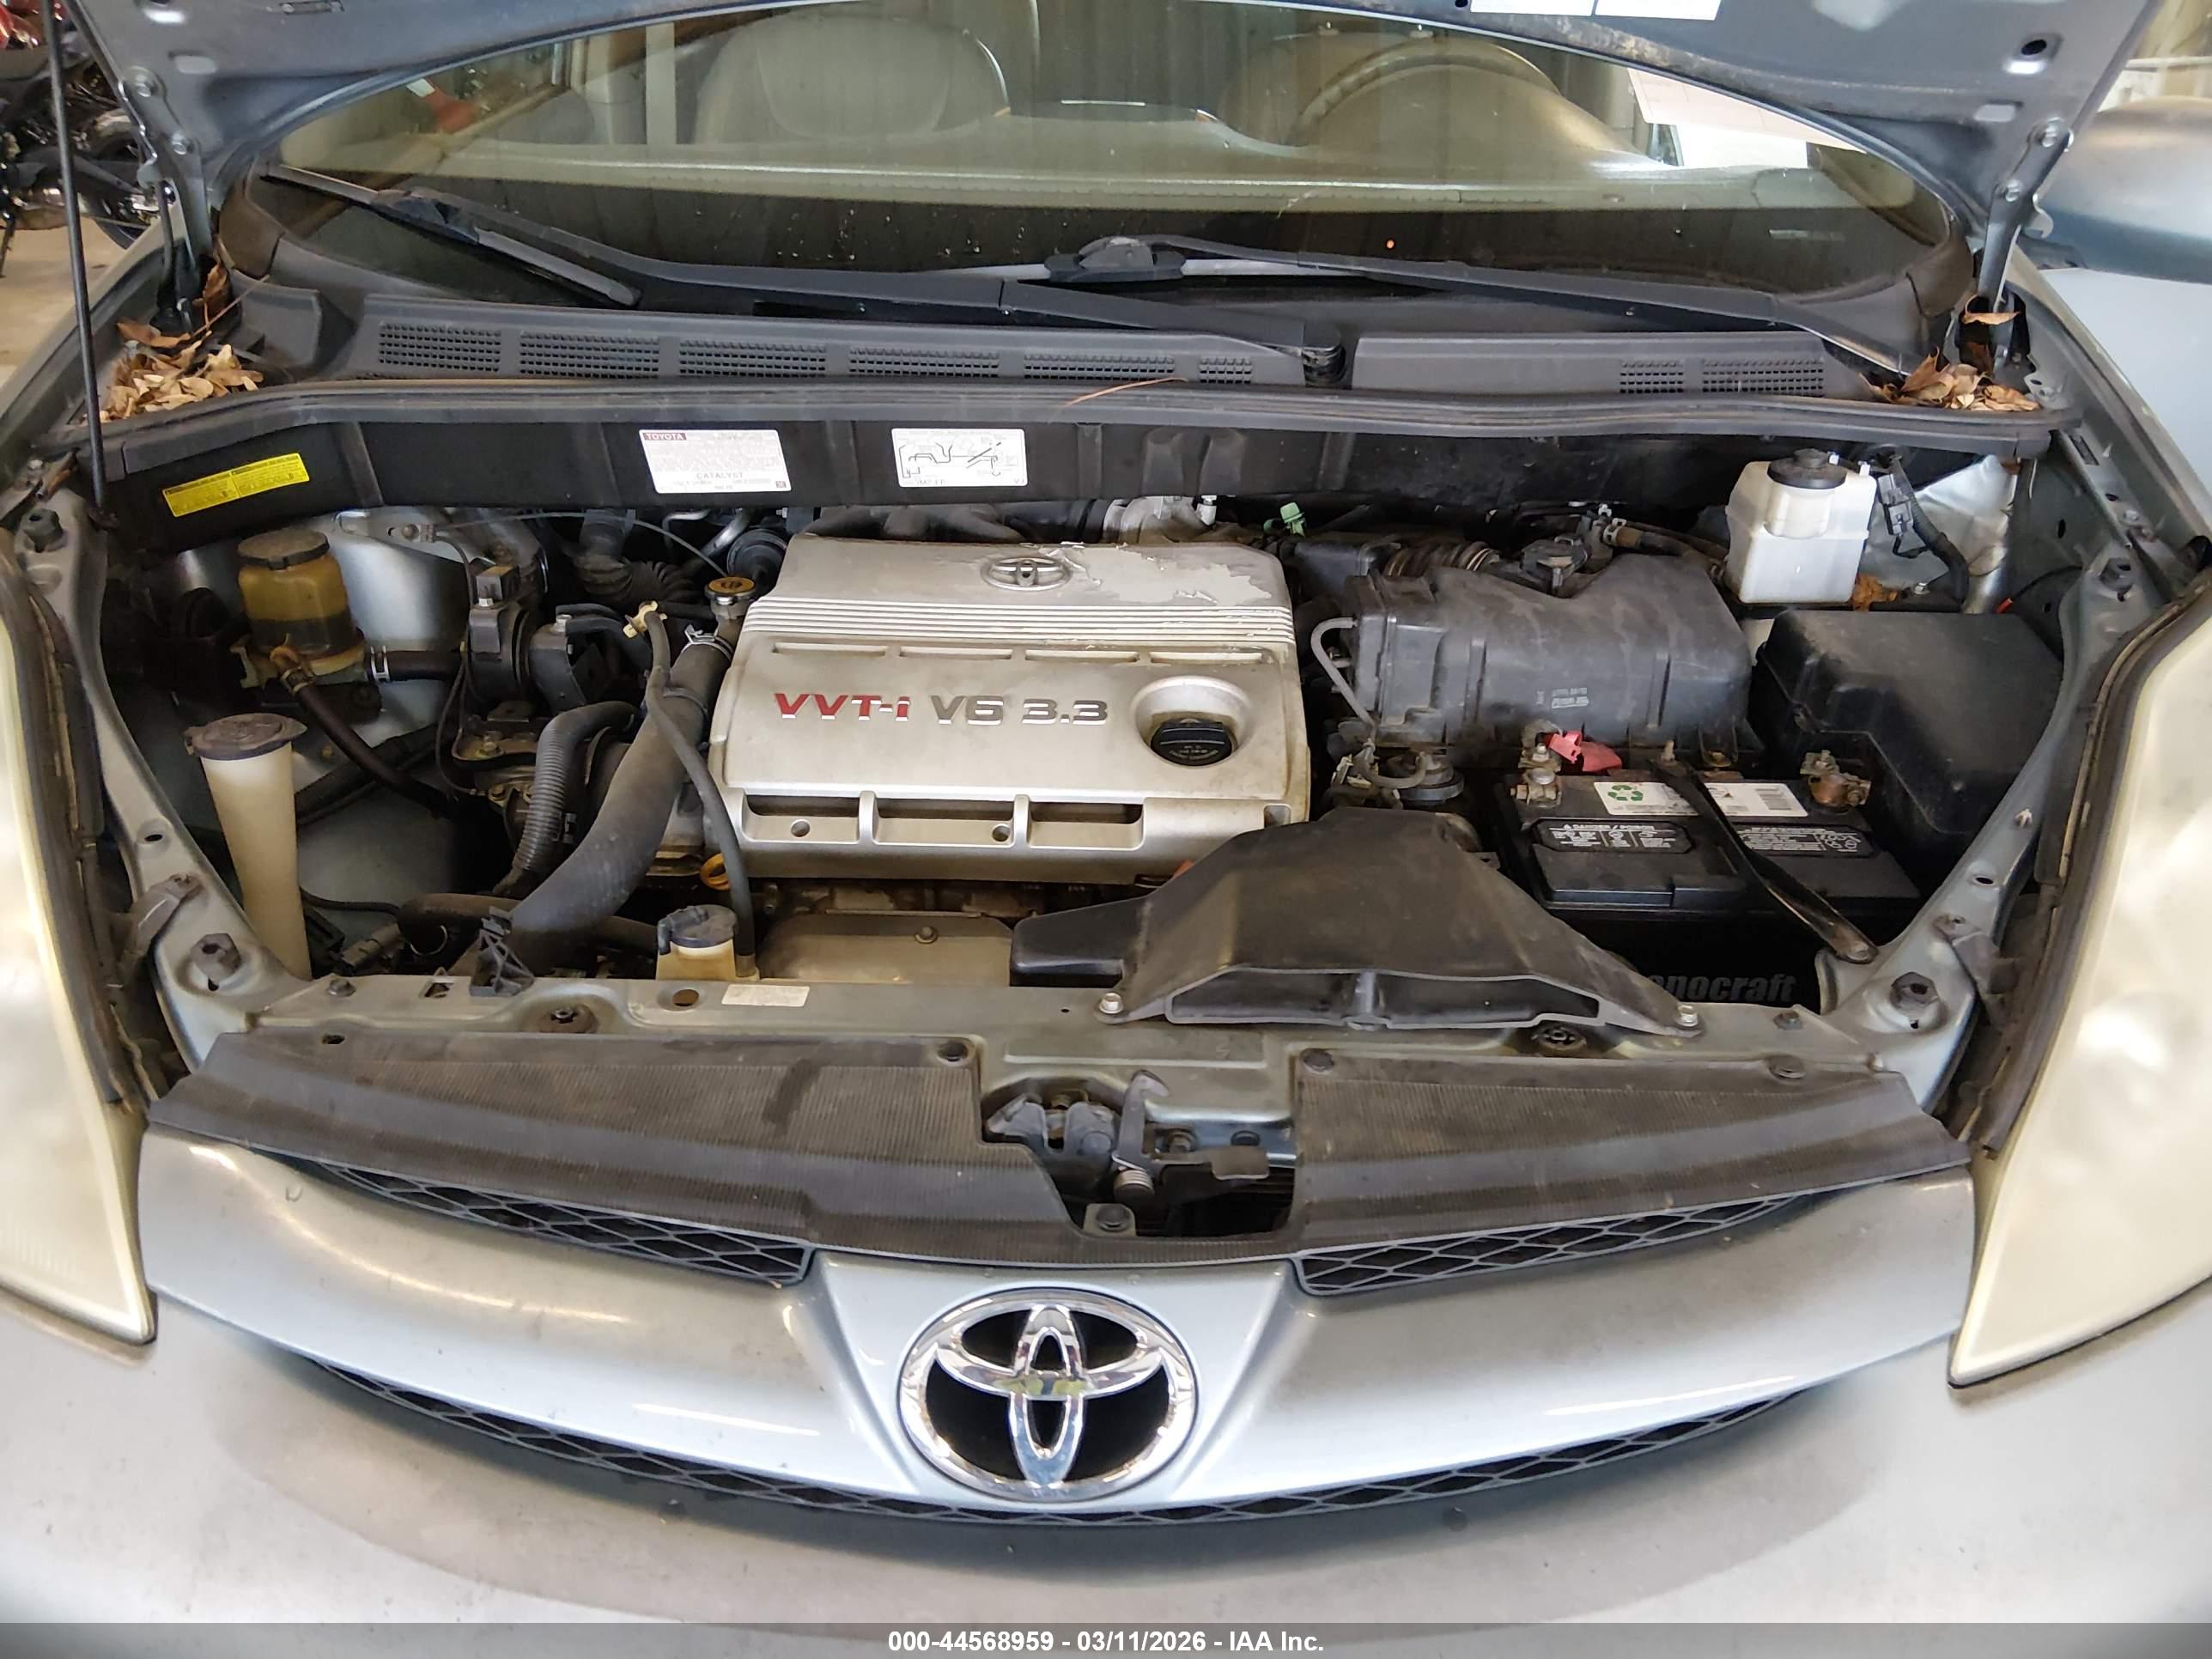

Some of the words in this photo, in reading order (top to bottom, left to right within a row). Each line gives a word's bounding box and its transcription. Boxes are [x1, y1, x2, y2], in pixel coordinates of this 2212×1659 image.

[775, 693, 911, 722] VVT-i
[930, 694, 1005, 726] V6
[1021, 698, 1109, 726] 3.3
